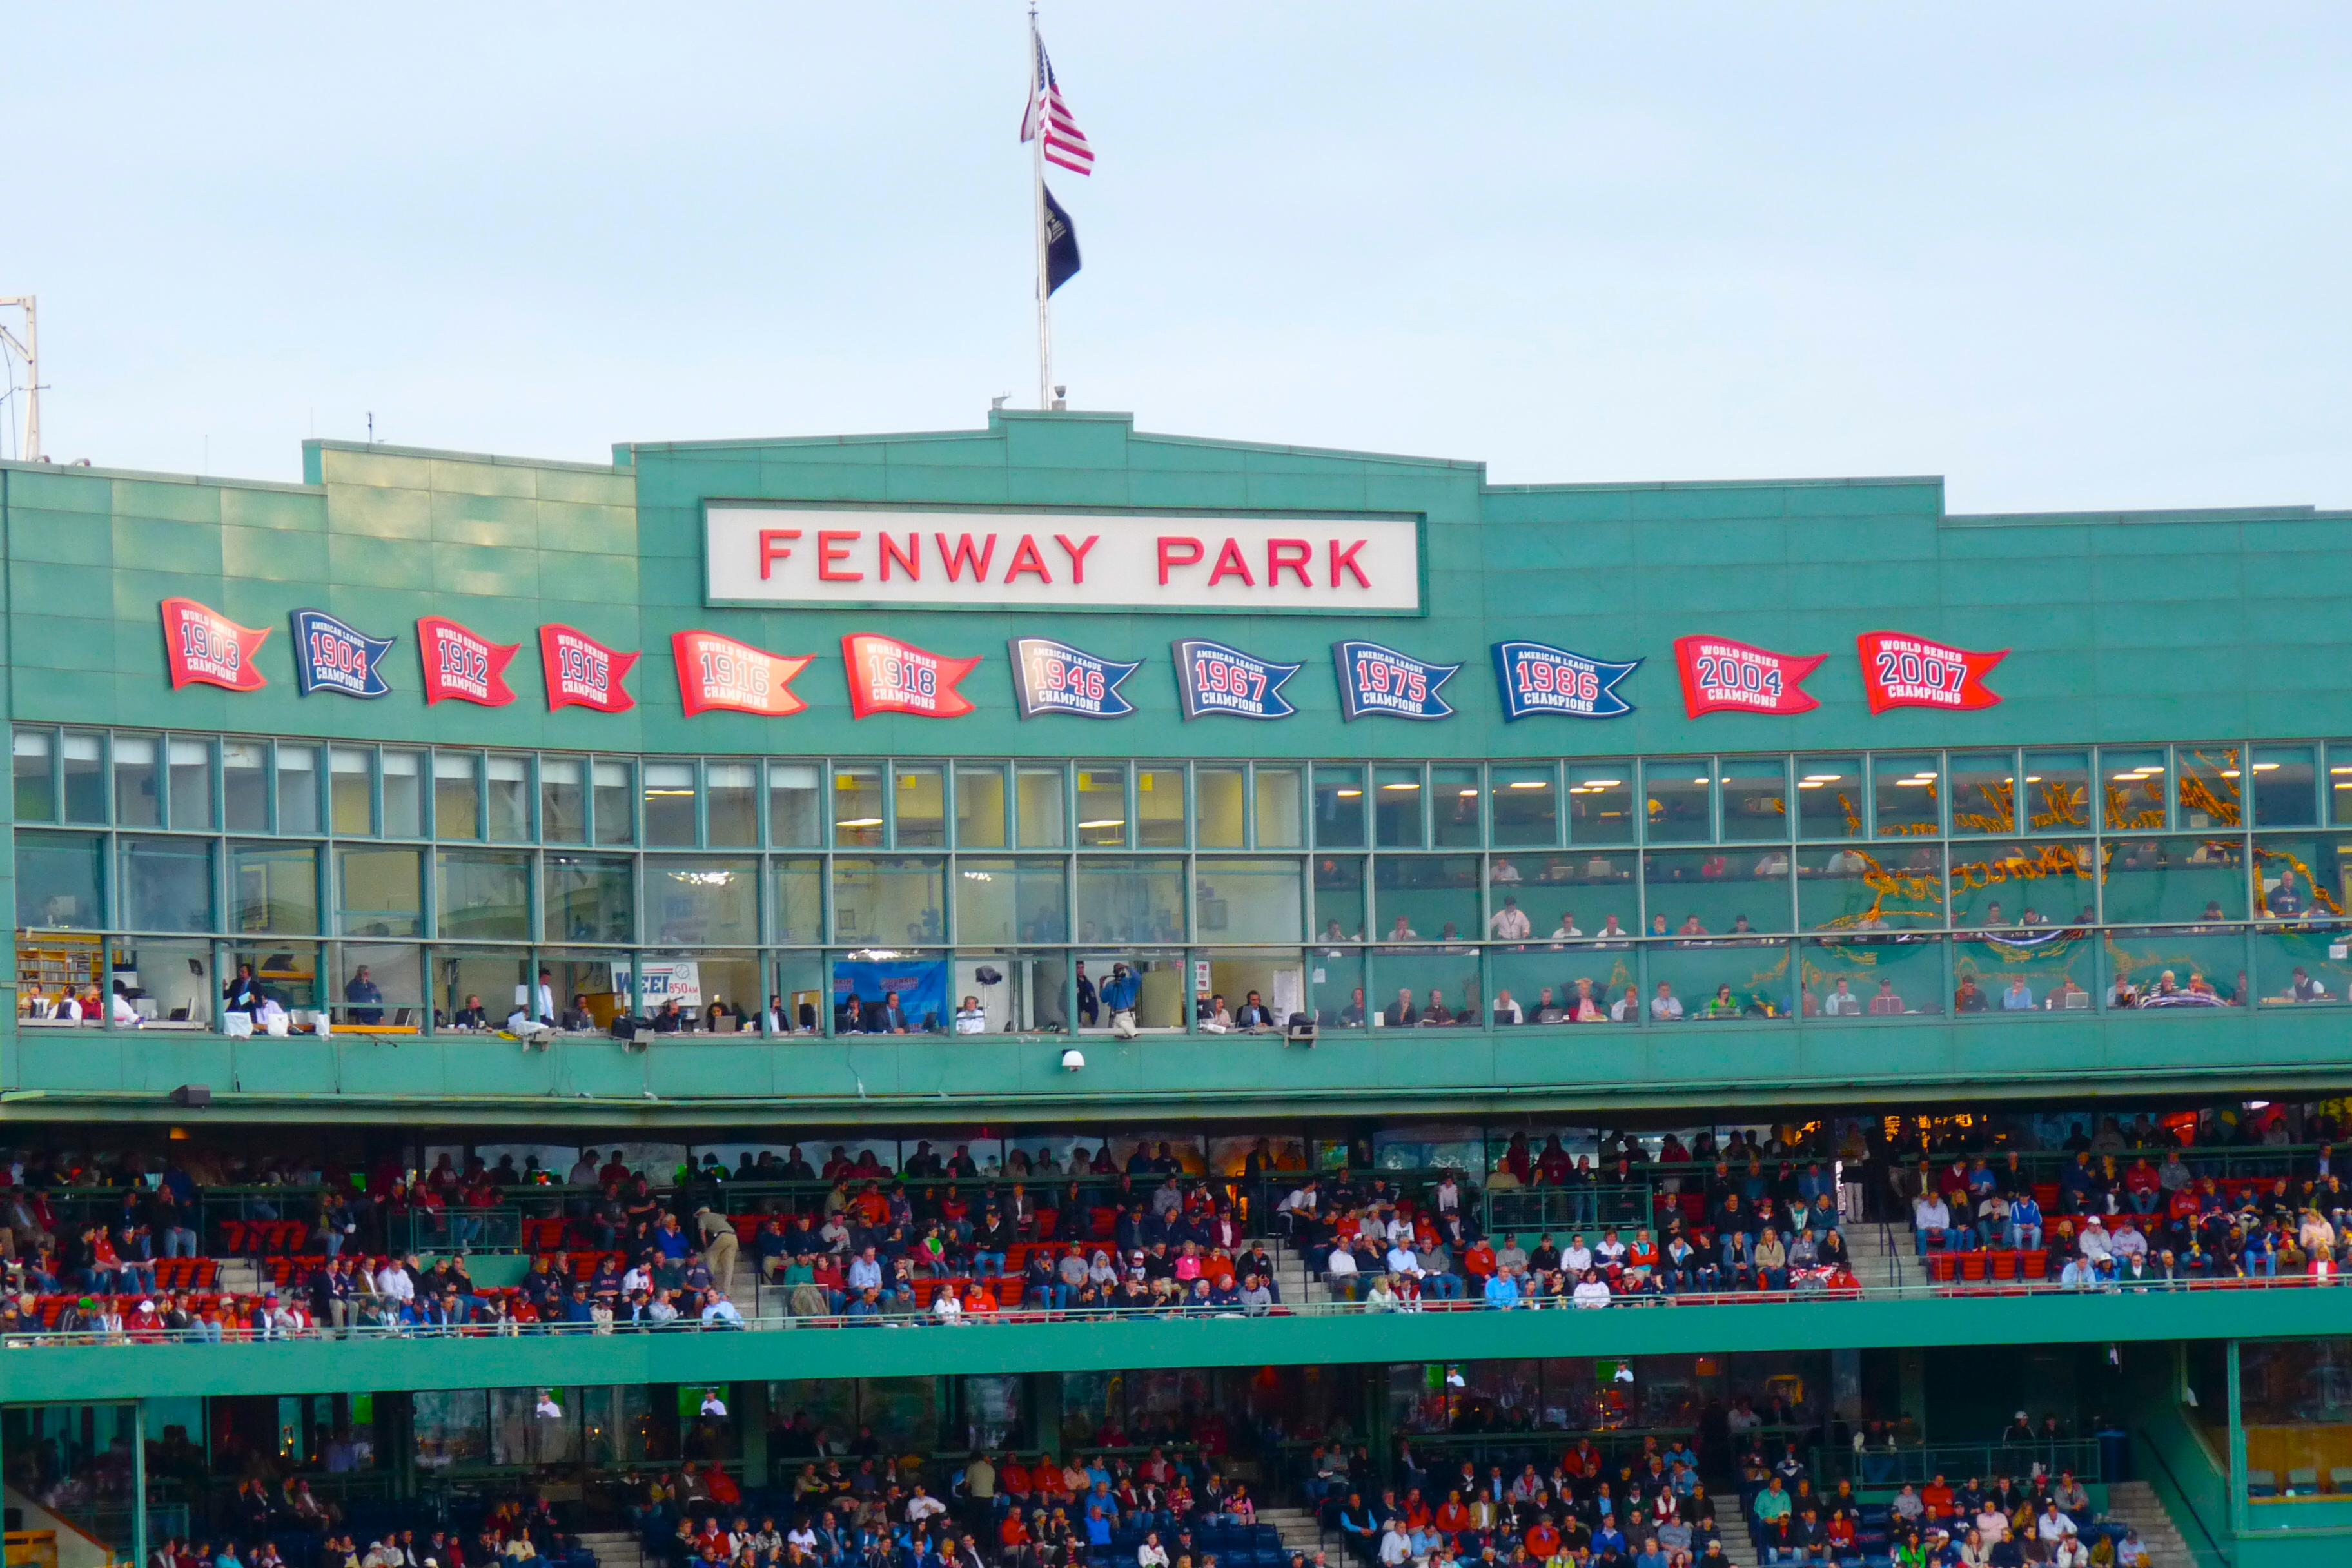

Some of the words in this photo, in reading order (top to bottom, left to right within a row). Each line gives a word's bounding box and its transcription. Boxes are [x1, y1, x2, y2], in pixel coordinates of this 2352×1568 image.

[760, 529, 1100, 583] FENWAY
[1157, 536, 1371, 588] PARK
[181, 609, 209, 625] WORLD
[210, 618, 237, 640] SERIES
[311, 621, 342, 637] AMERICAN
[343, 631, 365, 648] LEAGUE
[182, 622, 240, 671] 1903
[436, 627, 462, 643] WORLD
[463, 636, 487, 656] SERIES
[558, 634, 583, 650] WORLD
[583, 643, 609, 663] SERIES
[698, 641, 734, 655] WORLD
[736, 648, 770, 667] SERIES
[1880, 640, 1921, 653] WORLD
[1923, 645, 1962, 662] SERIES
[311, 632, 367, 680] 1904
[438, 640, 487, 686] 1912
[866, 643, 901, 658] WORLD
[903, 651, 937, 669] SERIES
[1033, 647, 1072, 662] AMERICAN
[1073, 656, 1102, 671] LEAGUE
[1197, 650, 1235, 664] AMERICAN
[1236, 658, 1264, 674] LEAGUE
[1357, 651, 1395, 664] AMERICAN
[1396, 658, 1424, 674] LEAGUE
[1518, 651, 1561, 663] AMERICAN
[1563, 658, 1595, 672] LEAGUE
[1701, 645, 1740, 658] WORLD
[1741, 651, 1778, 667] SERIES
[187, 658, 237, 682] CHAMPIONS
[316, 667, 364, 691] CHAMPIONS
[560, 647, 609, 691] 1915
[701, 652, 770, 696] 1916
[870, 655, 937, 697] 1918
[1032, 657, 1105, 700] 1946
[1195, 660, 1267, 701] 1967
[1357, 660, 1427, 702] 1975
[1516, 661, 1598, 701] 1986
[1697, 656, 1783, 696] 2004
[1877, 651, 1967, 692] 2007
[441, 674, 487, 698] CHAMPIONS
[562, 680, 608, 704] CHAMPIONS
[703, 686, 768, 708] CHAMPIONS
[872, 688, 935, 709] CHAMPIONS
[1708, 688, 1777, 707] CHAMPIONS
[1888, 685, 1961, 704] CHAMPIONS
[1039, 690, 1101, 712] CHAMPIONS
[1202, 692, 1262, 713] CHAMPIONS
[1362, 692, 1422, 713] CHAMPIONS
[1524, 692, 1593, 712] CHAMPIONS
[616, 972, 669, 994] WEEI
[669, 983, 688, 994] 850
